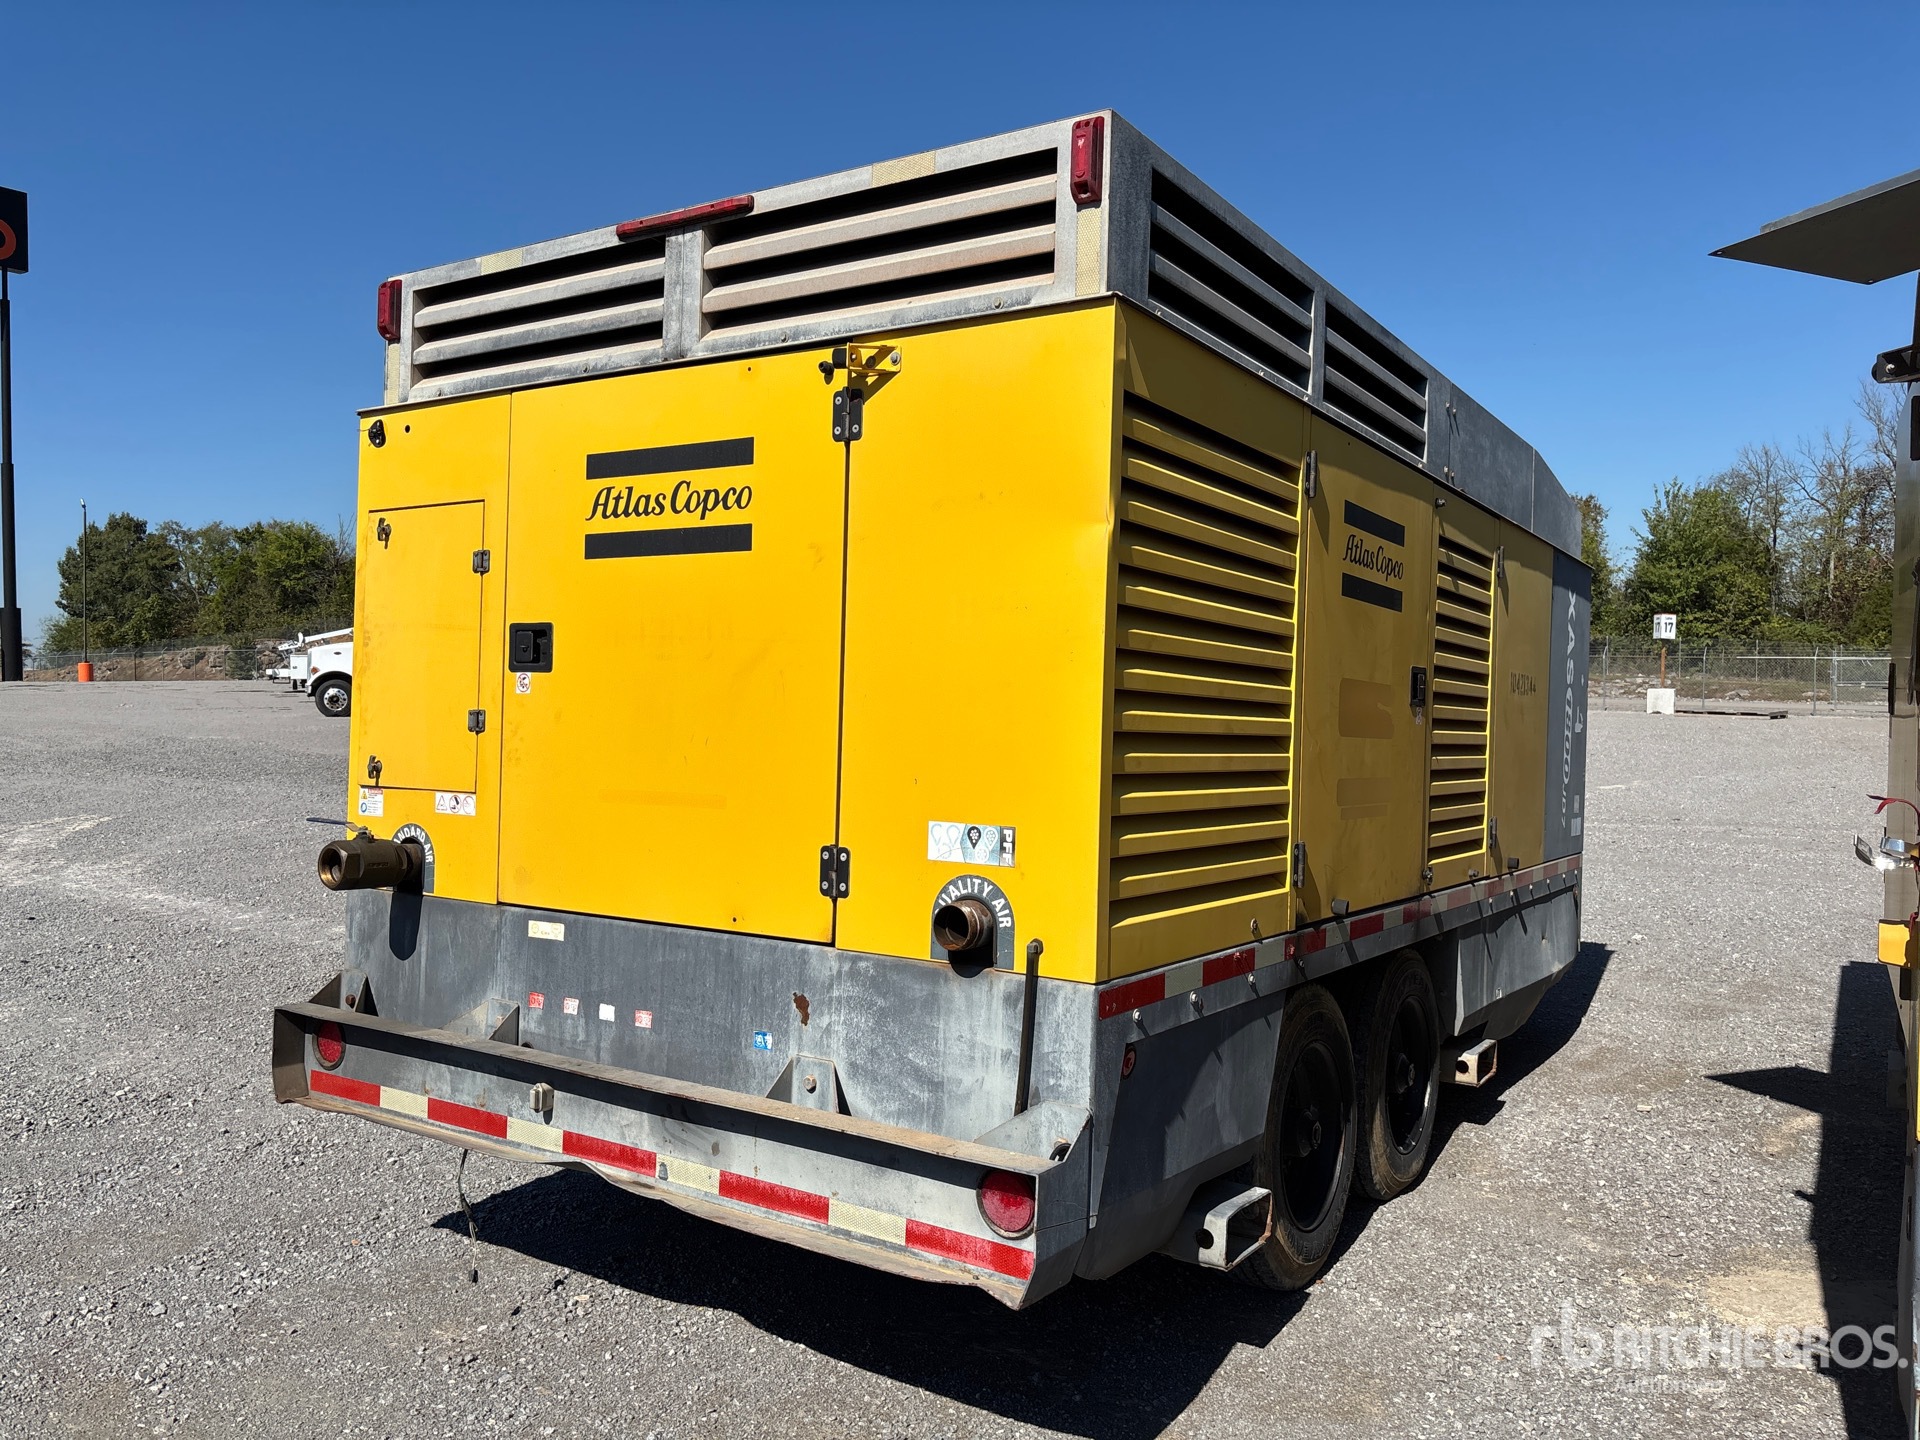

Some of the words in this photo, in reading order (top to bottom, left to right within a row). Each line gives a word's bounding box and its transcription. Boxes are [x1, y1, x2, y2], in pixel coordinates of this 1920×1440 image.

[585, 486, 666, 521] Atlas
[670, 480, 753, 520] Copco
[1342, 534, 1375, 571] Atlas
[1375, 545, 1404, 582] Copco
[1566, 588, 1577, 685] XAS
[1664, 621, 1674, 633] 17
[424, 843, 434, 863] AIR
[1003, 828, 1013, 867] PFF
[934, 878, 994, 914] UALITY
[992, 897, 1012, 928] AIR
